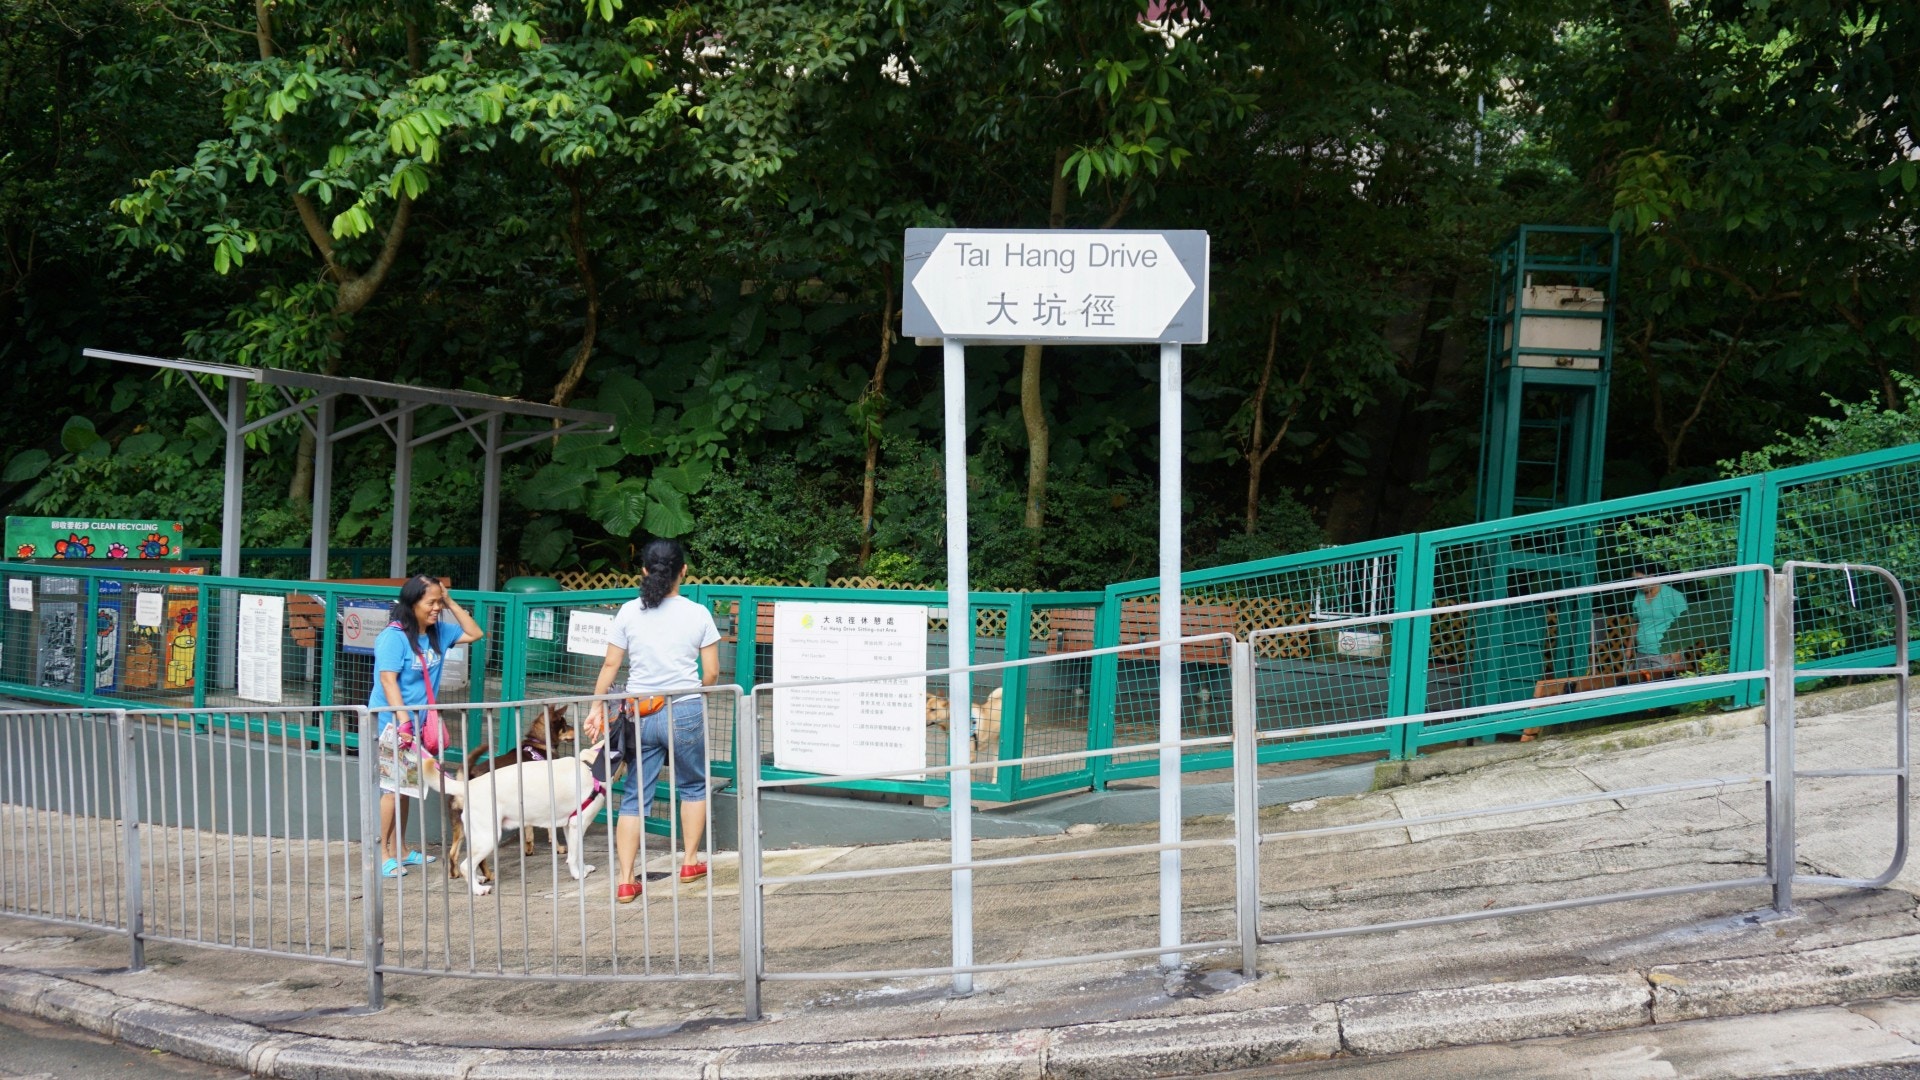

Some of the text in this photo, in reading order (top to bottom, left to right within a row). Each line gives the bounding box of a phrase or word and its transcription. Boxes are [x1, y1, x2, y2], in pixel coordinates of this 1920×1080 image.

[953, 242, 1157, 273] Tai Hang Drive
[986, 292, 1115, 328] 大坑徑
[91, 522, 116, 530] CLEAN
[117, 523, 158, 531] RECYCLING
[823, 615, 895, 626] 大坑徑休憩處
